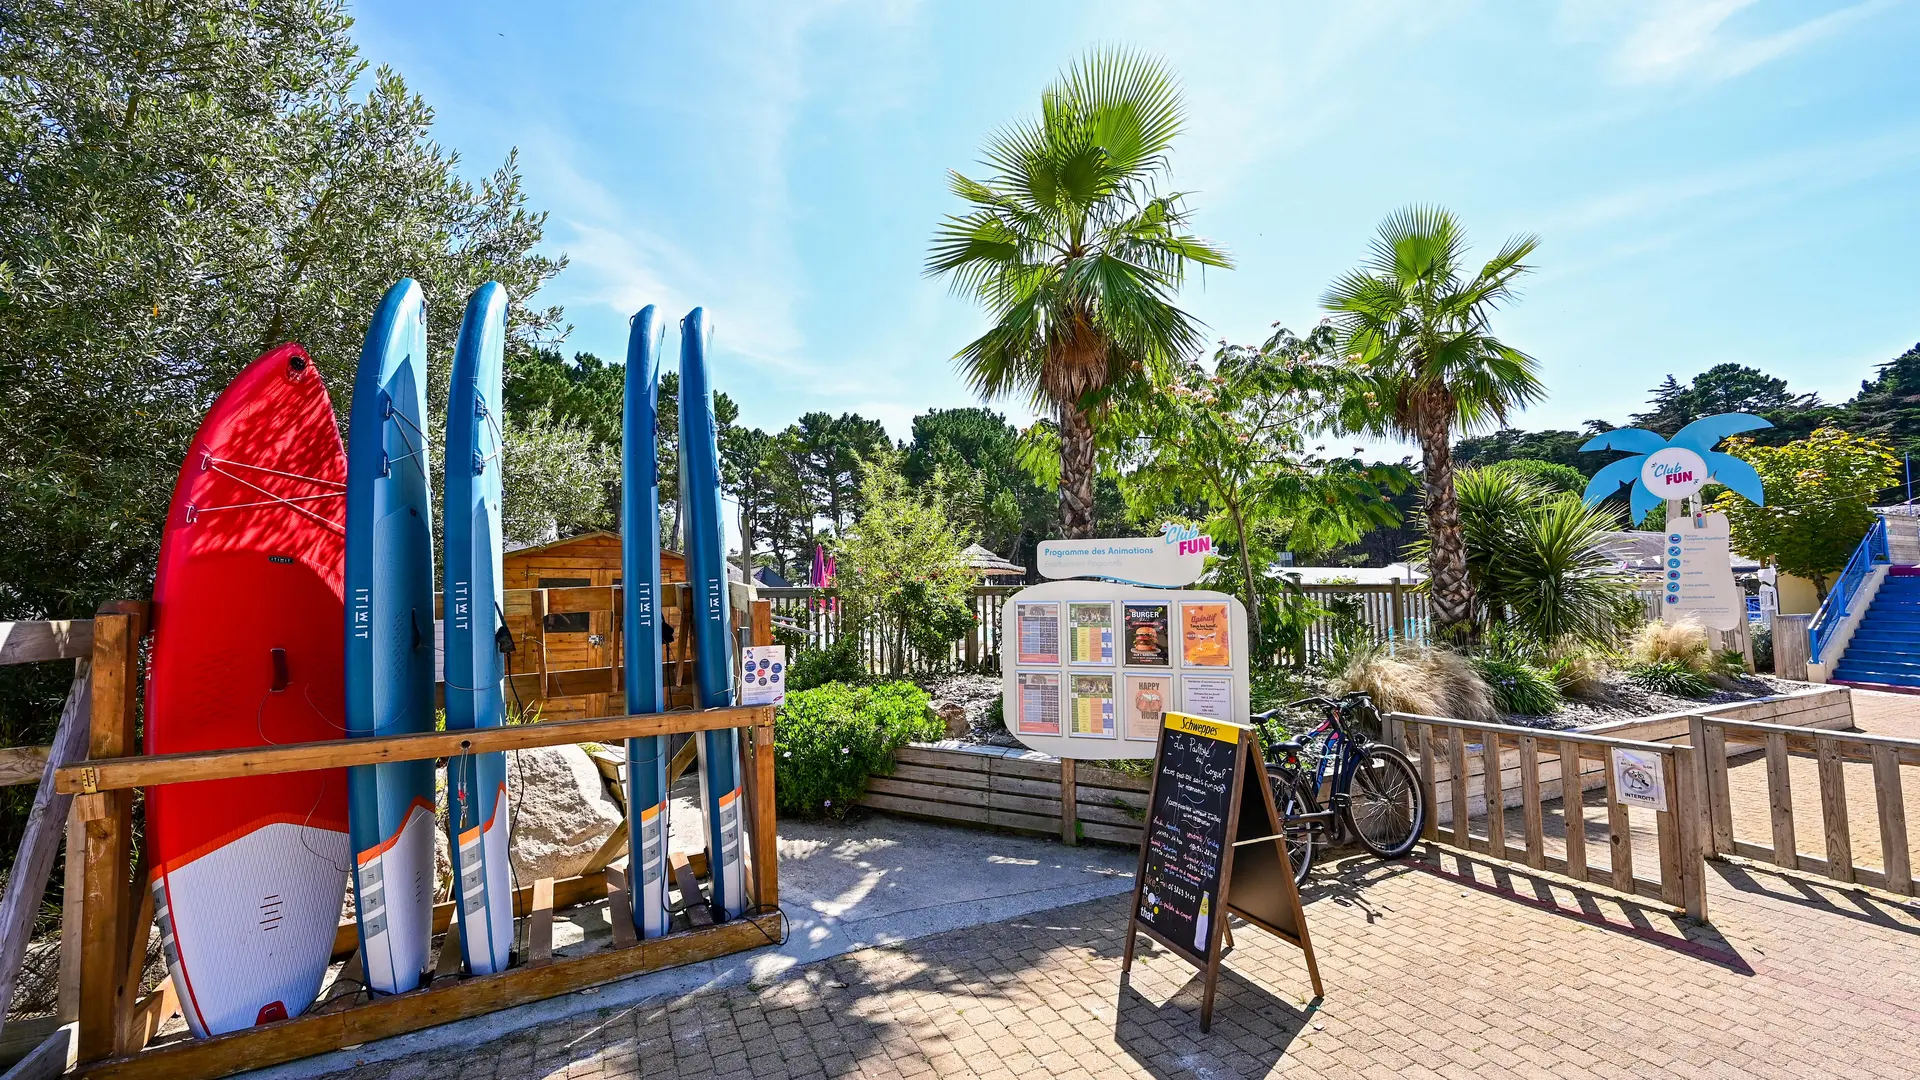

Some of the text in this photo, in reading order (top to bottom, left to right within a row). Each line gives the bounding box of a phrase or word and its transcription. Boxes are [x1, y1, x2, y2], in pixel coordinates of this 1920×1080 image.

[1654, 462, 1682, 478] Club
[1666, 471, 1692, 485] FUN
[1166, 523, 1199, 544] Club
[1045, 547, 1154, 558] Programme des Animations
[1179, 537, 1210, 556] FUN
[455, 582, 468, 629] ITIWIT
[640, 583, 651, 627] ITIWIT
[709, 579, 720, 620] ITIWIT
[355, 589, 369, 638] ITIWIT
[1138, 682, 1160, 690] HAPPY
[1142, 712, 1159, 720] HOUR
[1181, 717, 1218, 736] Schweppes
[1625, 793, 1655, 801] INTERDITS
[1143, 883, 1149, 895] it
